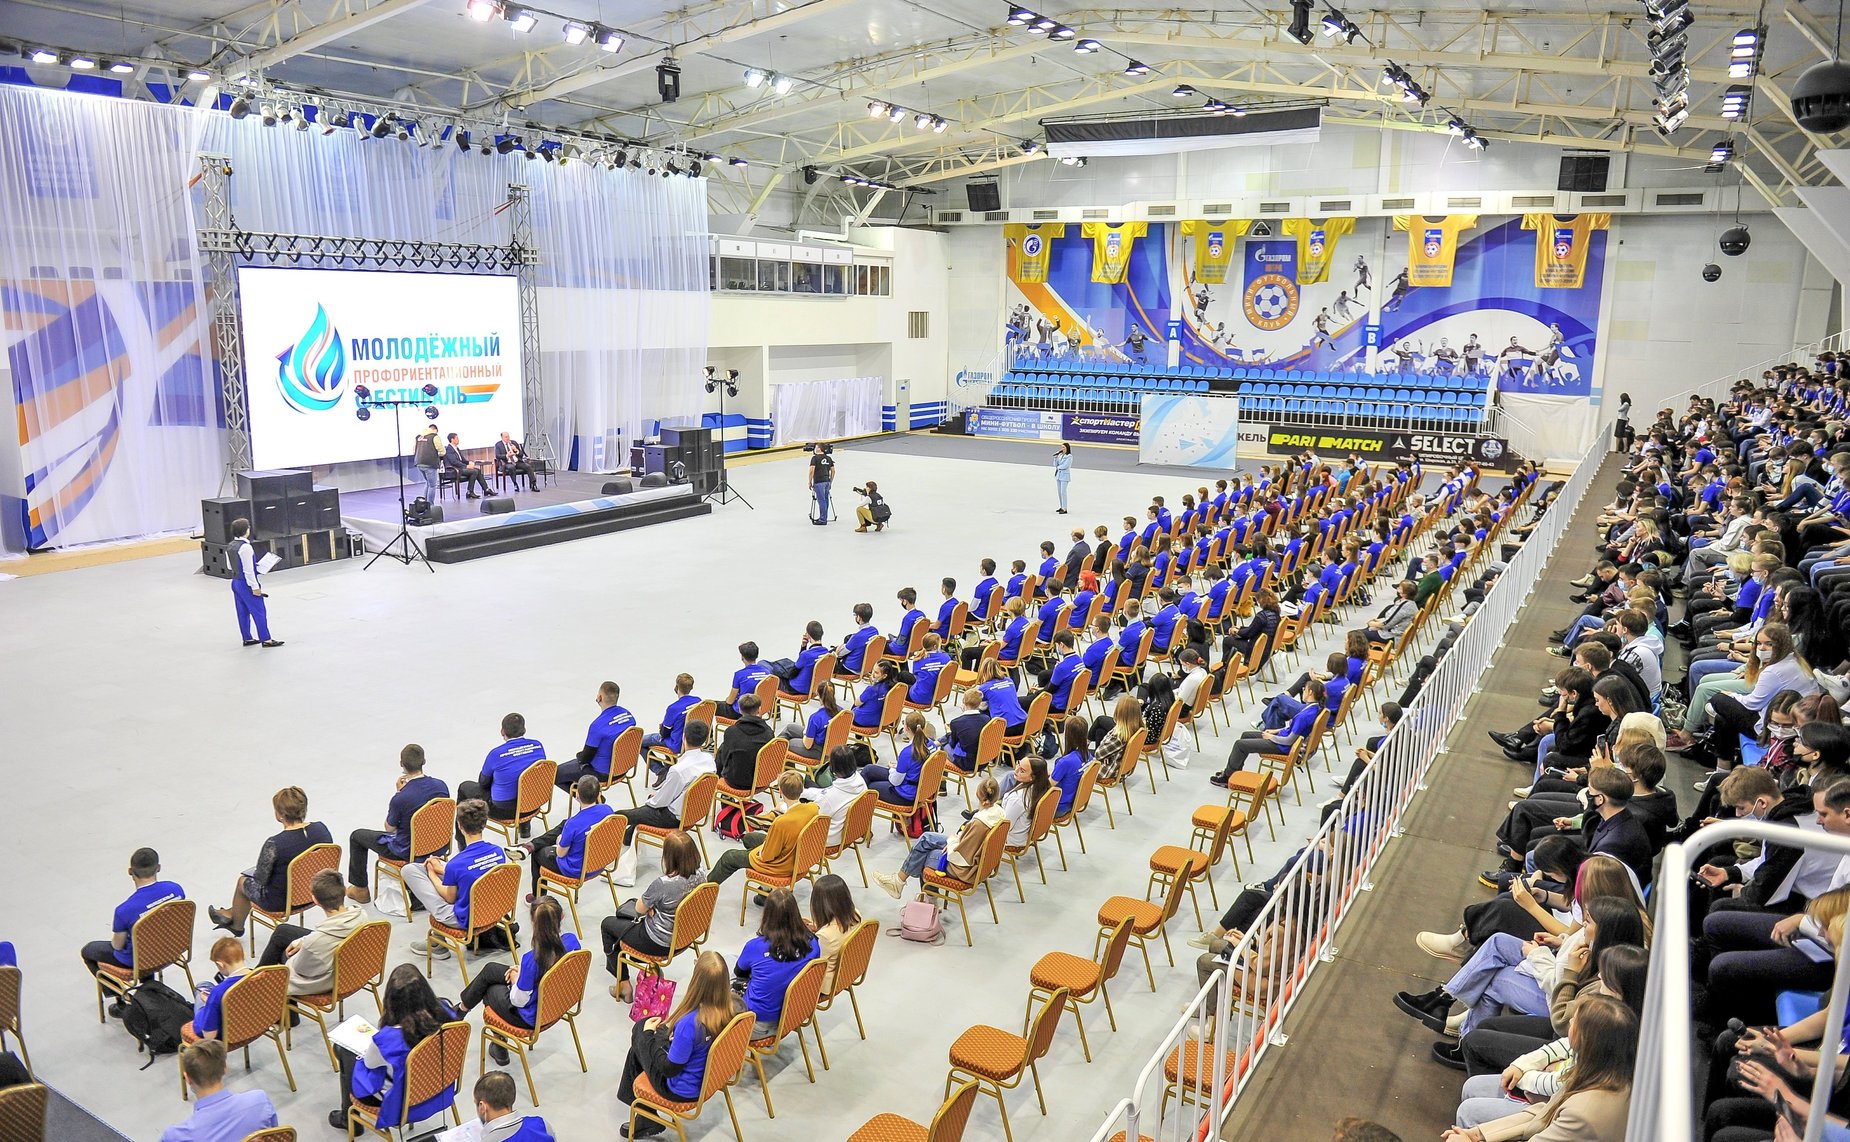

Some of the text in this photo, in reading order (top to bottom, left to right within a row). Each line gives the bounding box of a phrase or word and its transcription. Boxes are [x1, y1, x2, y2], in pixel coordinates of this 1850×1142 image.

[351, 331, 501, 364] МОЛОДЁЖНЫЙ
[980, 420, 1026, 429] МИНИ-ФУТБОЛ
[1037, 423, 1061, 431] ШКОЛУ
[1238, 432, 1267, 443] КЕЛЬ
[1271, 433, 1384, 452] PARI MATCH
[1410, 435, 1476, 455] SELECT
